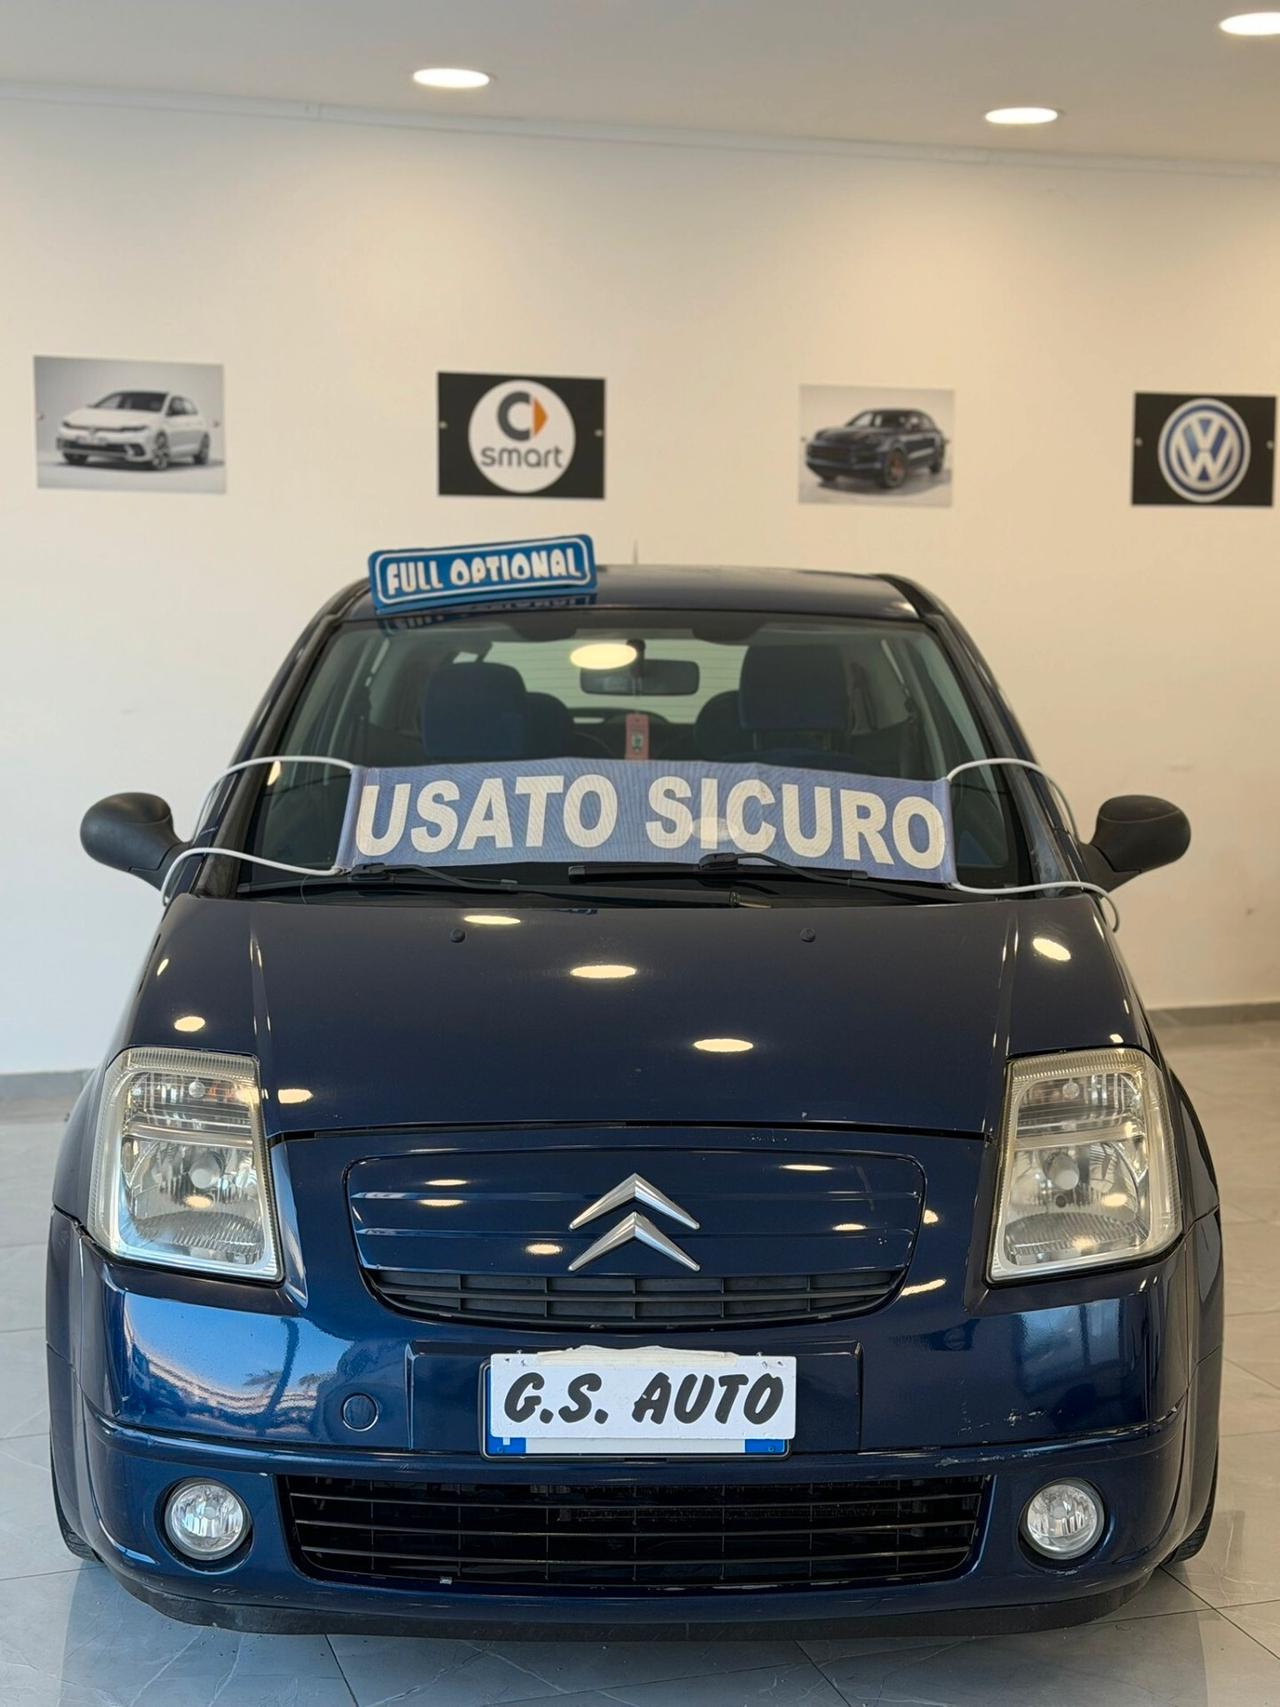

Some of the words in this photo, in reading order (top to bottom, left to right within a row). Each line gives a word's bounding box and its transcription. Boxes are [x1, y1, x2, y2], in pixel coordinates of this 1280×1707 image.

[480, 446, 563, 468] smart
[386, 561, 443, 596] FULL
[450, 547, 581, 586] OPTIONAL
[355, 774, 618, 857] USATO
[645, 776, 945, 870] SICURO
[504, 1372, 609, 1425] G.S.
[631, 1372, 784, 1425] AUTO
